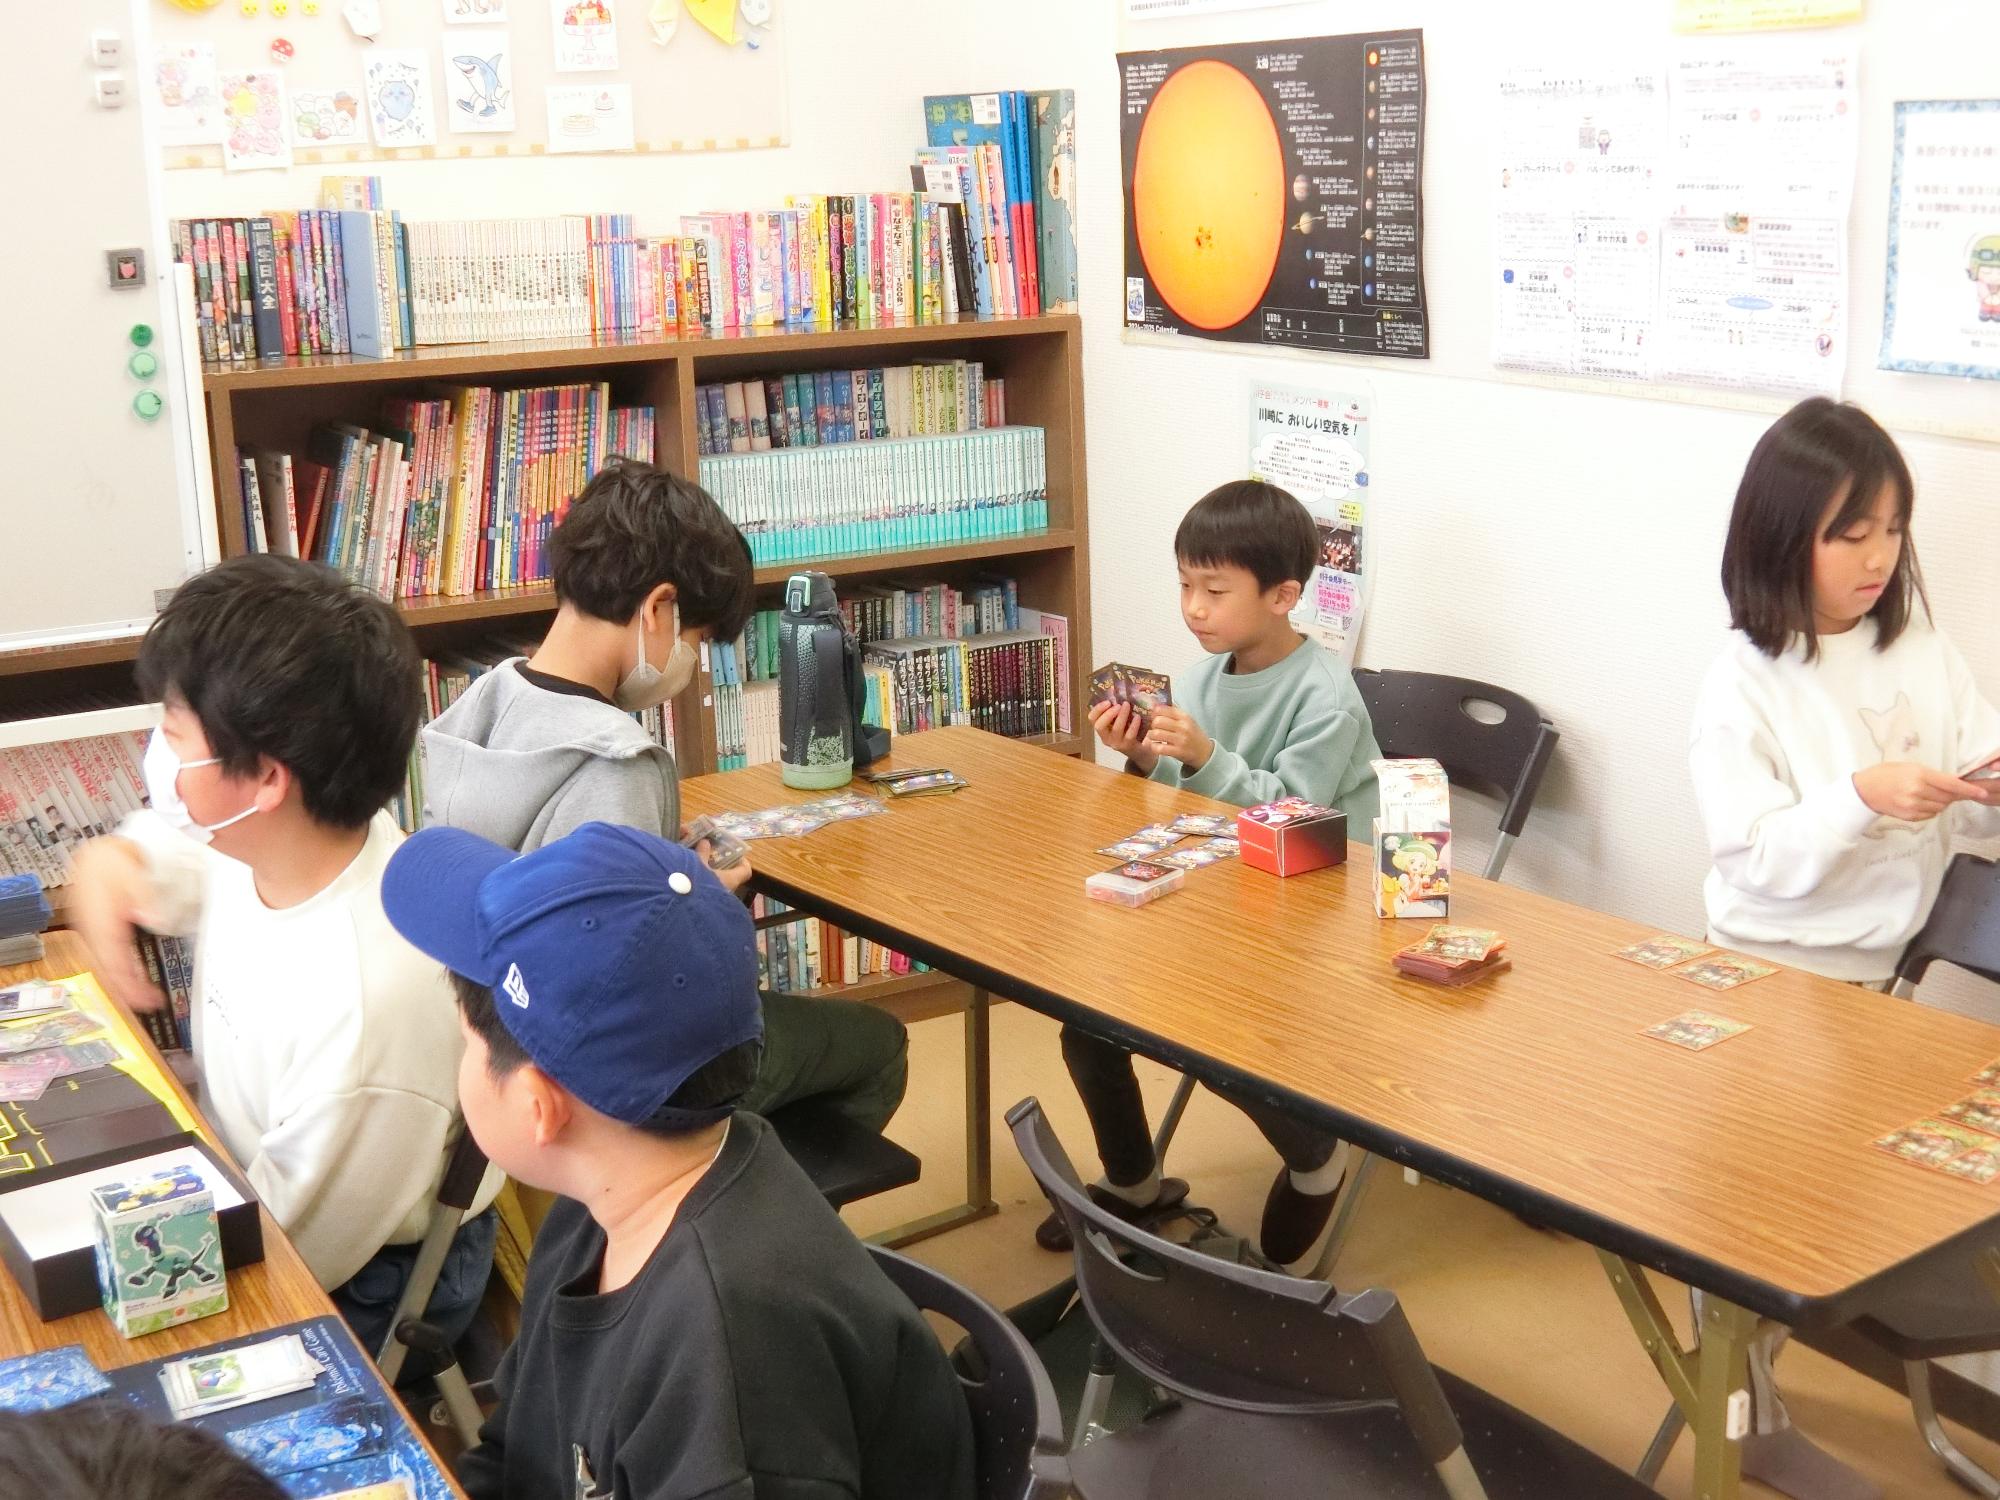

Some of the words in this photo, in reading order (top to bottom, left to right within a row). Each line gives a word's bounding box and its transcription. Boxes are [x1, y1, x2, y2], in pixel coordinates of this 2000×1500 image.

[893, 218, 902, 247] なぞなぞ
[256, 231, 276, 310] 誕生日大全
[856, 375, 868, 440] ライオンボーイ
[872, 373, 884, 438] ライオンボーイ
[1259, 408, 1284, 424] 川崎に
[924, 654, 933, 692] 暗号クラブ
[940, 652, 948, 690] 暗号クラブ
[903, 695, 908, 706] 1
[910, 697, 917, 706] 2
[943, 692, 949, 701] 6
